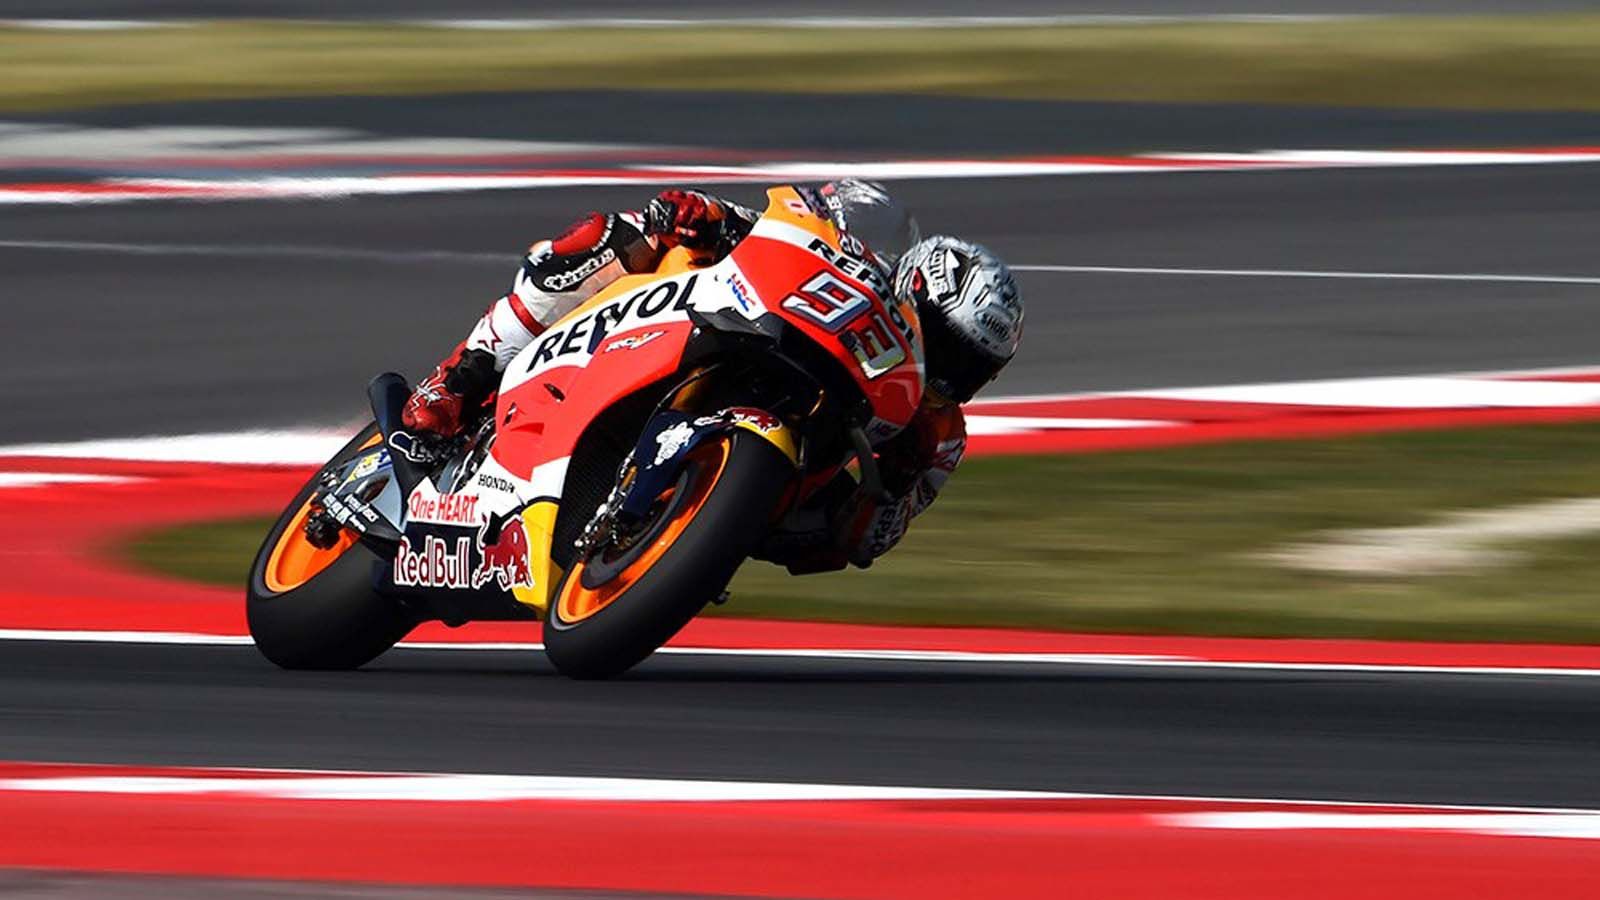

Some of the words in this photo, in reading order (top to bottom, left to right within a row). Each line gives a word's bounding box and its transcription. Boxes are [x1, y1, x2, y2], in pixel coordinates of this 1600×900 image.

[783, 271, 907, 379] 93
[478, 474, 516, 494] HONDA
[410, 491, 435, 518] One
[394, 536, 433, 586] Red
[434, 537, 470, 588] Bull
